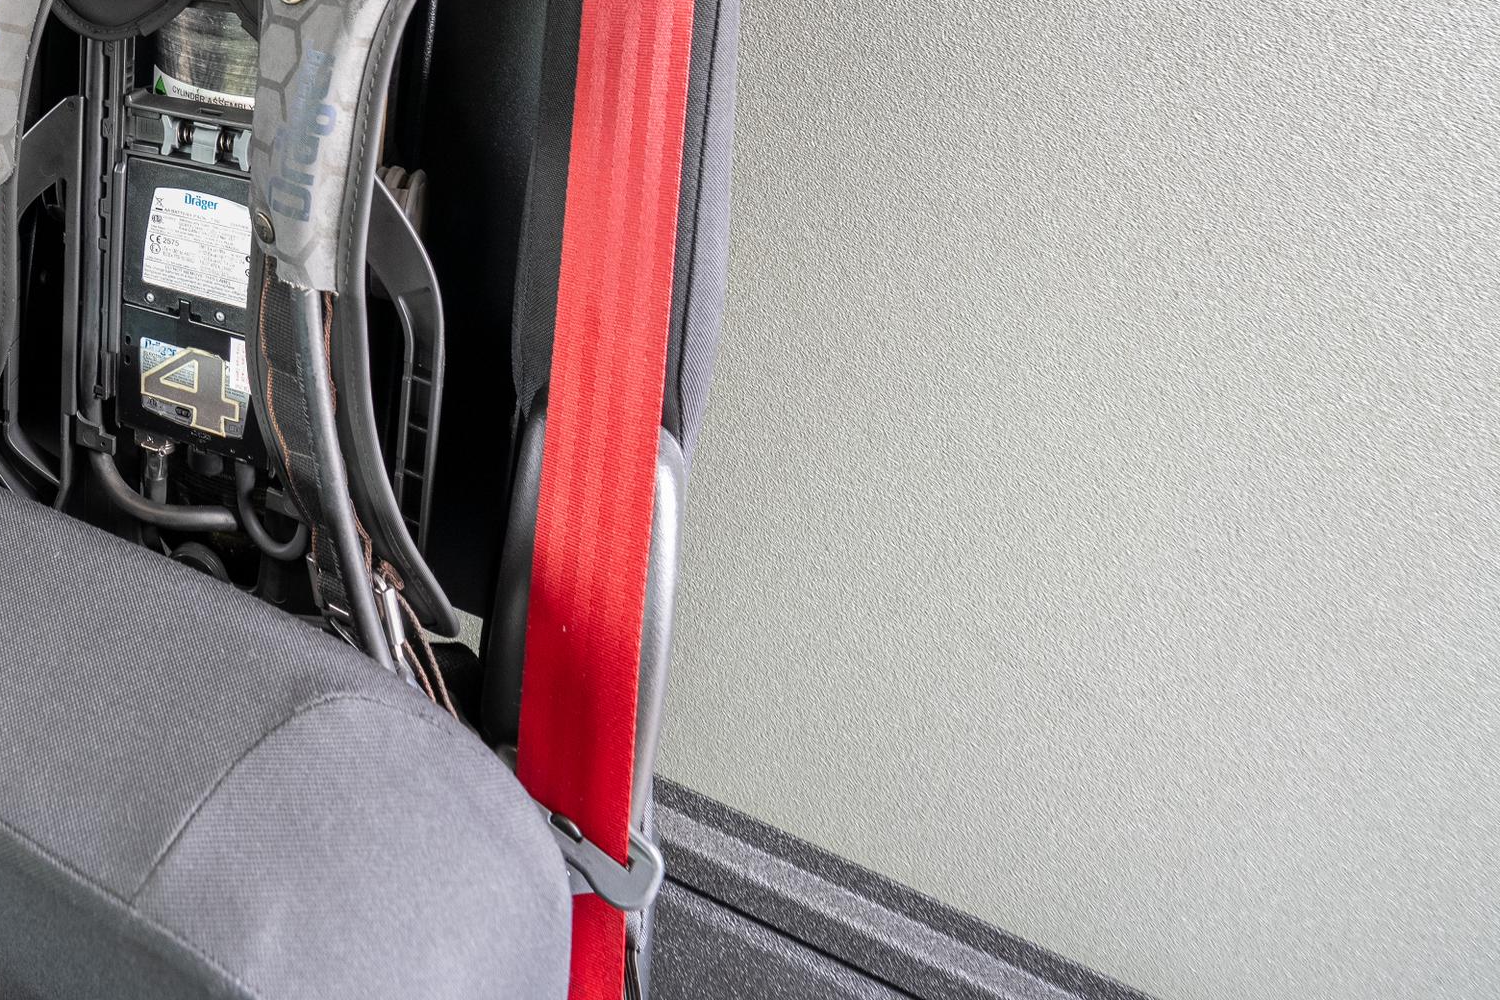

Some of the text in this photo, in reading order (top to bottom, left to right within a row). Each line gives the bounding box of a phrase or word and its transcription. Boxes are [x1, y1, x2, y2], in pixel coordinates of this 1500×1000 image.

[172, 85, 206, 103] CYLINDER
[184, 192, 219, 210] Dräger
[141, 347, 240, 439] 4
